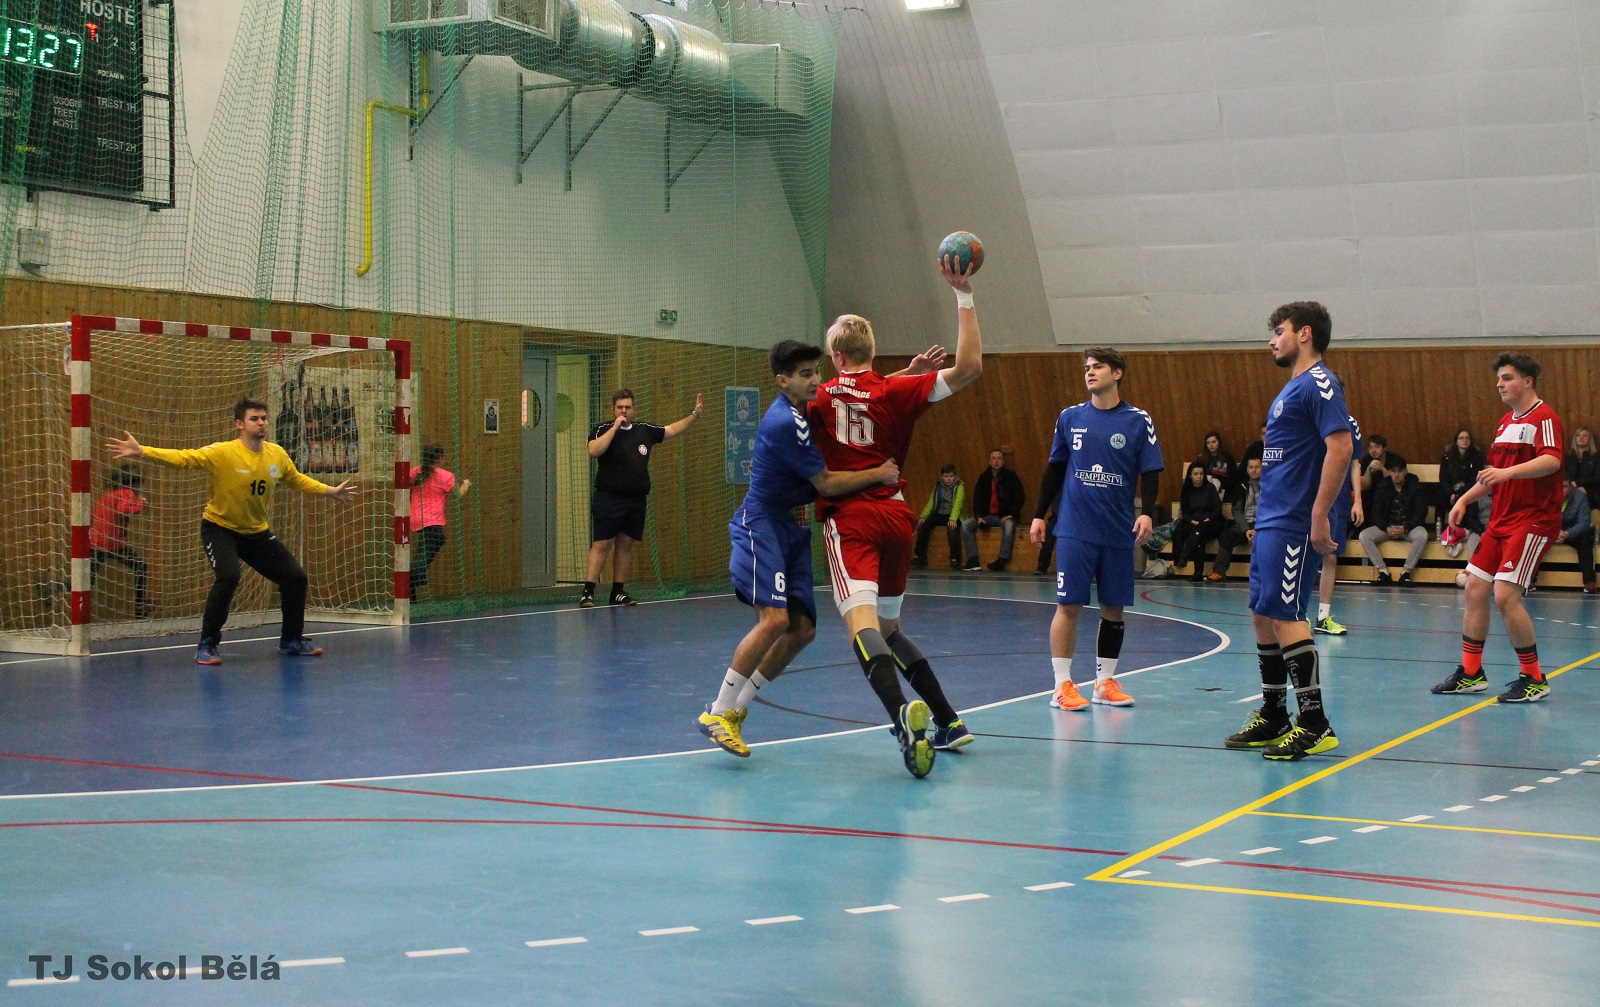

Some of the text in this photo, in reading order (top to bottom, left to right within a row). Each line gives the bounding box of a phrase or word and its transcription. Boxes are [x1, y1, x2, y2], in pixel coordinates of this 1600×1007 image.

[96, 96, 123, 109] TREST
[53, 106, 78, 118] TREST
[96, 137, 137, 152] TREST 2H
[838, 377, 856, 387] HBC
[831, 398, 875, 446] 15
[1072, 433, 1083, 451] 5
[250, 479, 266, 496] 16
[775, 571, 786, 593] 6
[1057, 571, 1065, 589] 5
